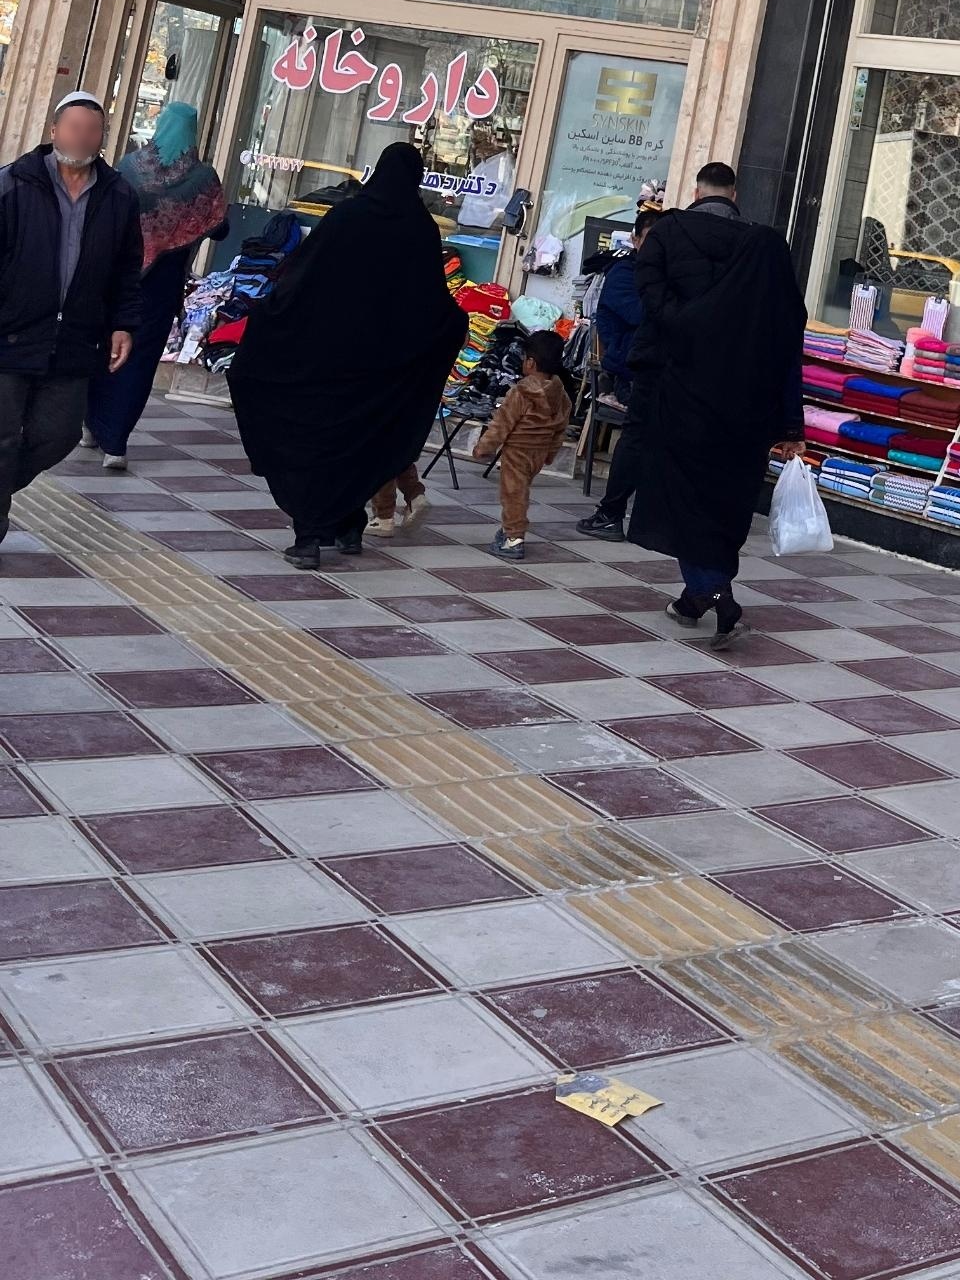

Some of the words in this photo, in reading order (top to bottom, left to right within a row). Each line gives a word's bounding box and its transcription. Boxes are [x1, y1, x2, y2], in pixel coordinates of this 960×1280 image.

[271, 26, 500, 125] داروخانه
[591, 112, 651, 136] SYNSKIN
[628, 134, 643, 147] BB
[643, 139, 665, 152] کرم
